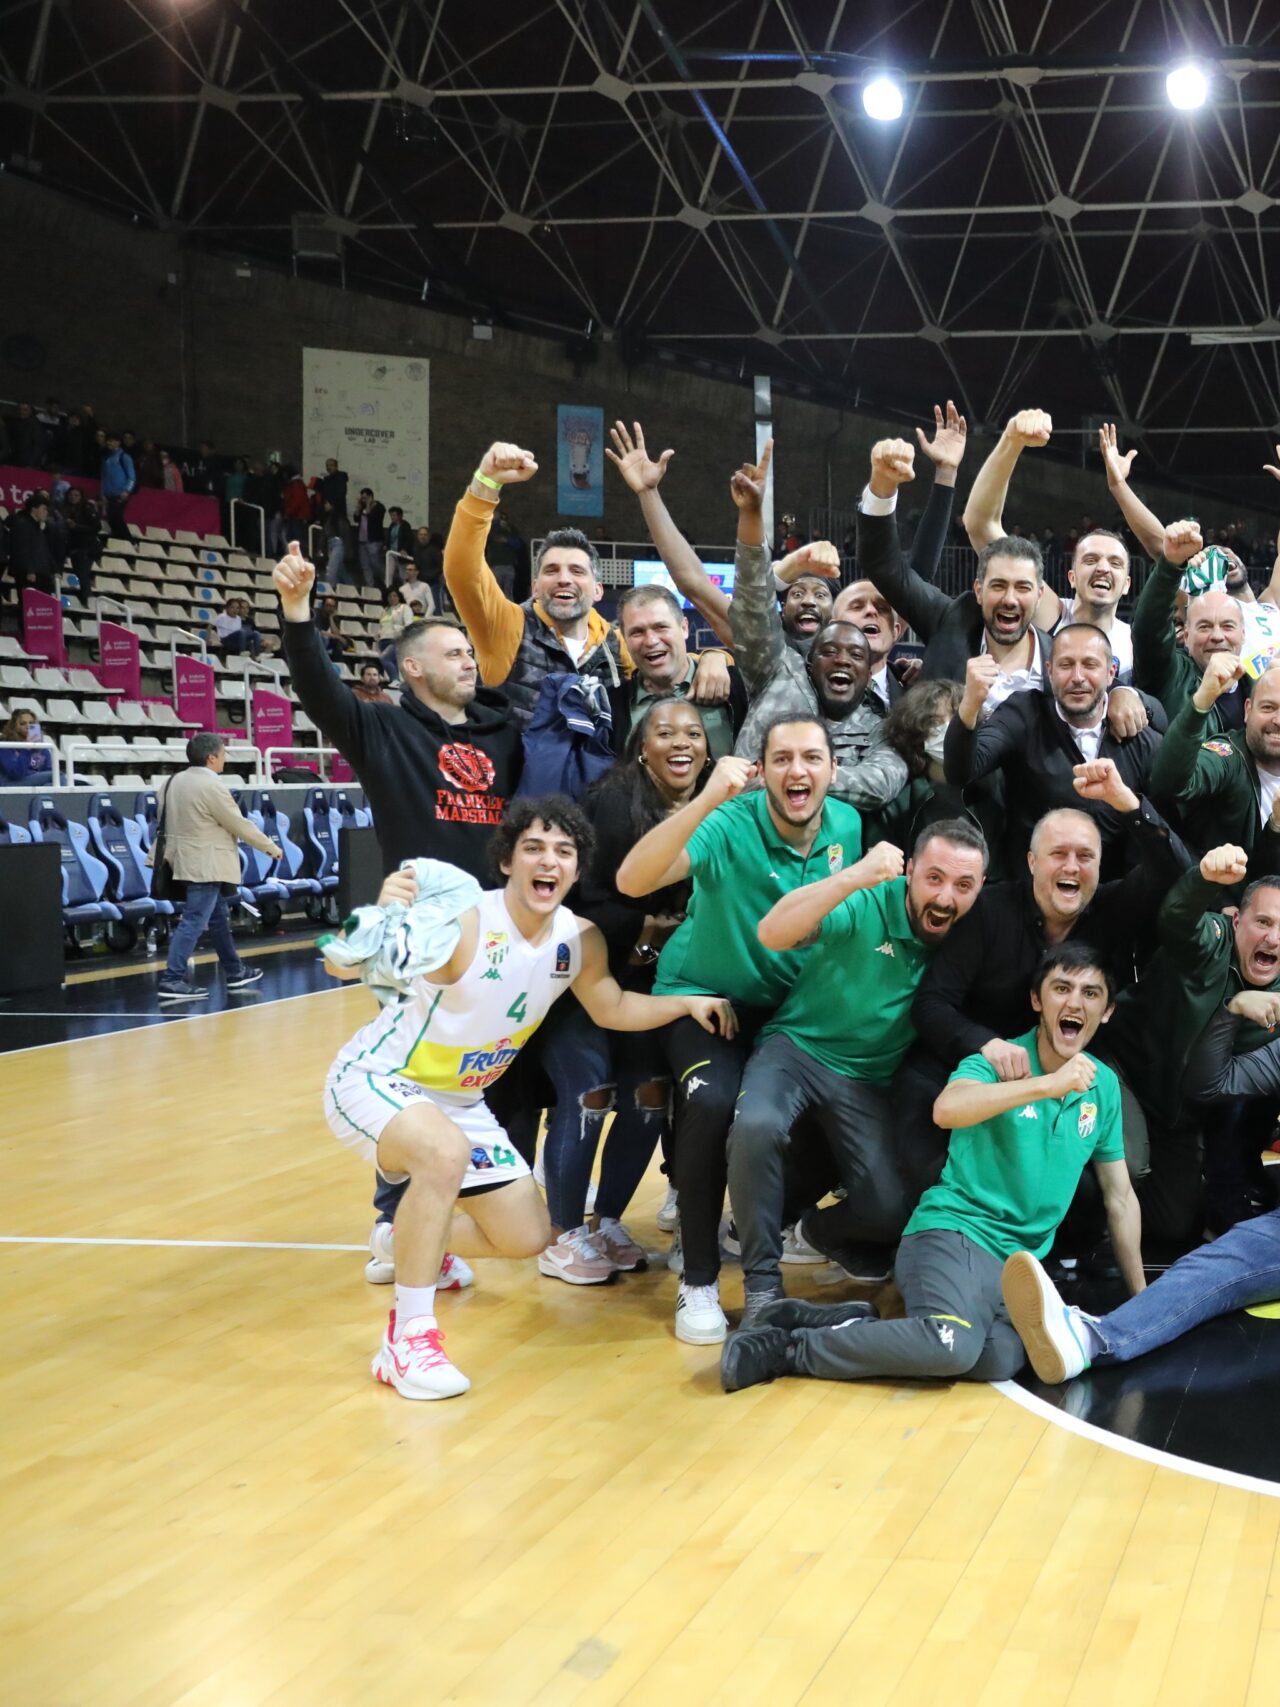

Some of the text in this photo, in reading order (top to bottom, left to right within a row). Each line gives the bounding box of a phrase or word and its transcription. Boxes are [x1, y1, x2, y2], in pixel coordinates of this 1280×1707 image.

[344, 427, 395, 438] UNDERCOVER
[1256, 616, 1273, 636] 5
[507, 992, 528, 1023] 4
